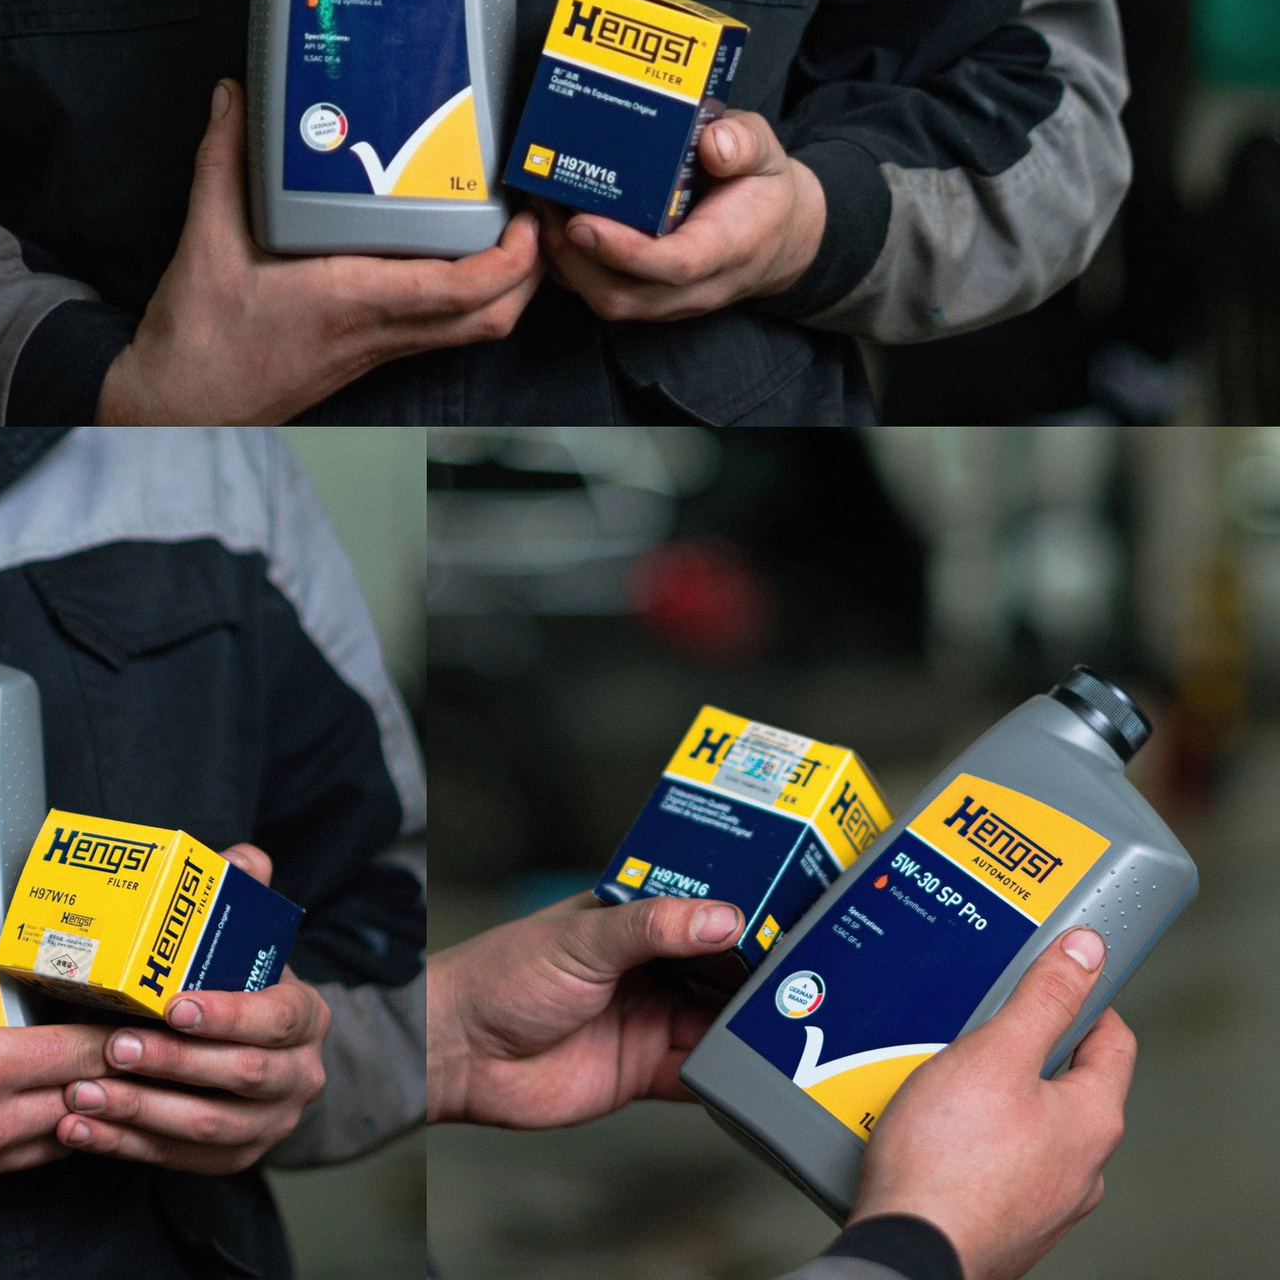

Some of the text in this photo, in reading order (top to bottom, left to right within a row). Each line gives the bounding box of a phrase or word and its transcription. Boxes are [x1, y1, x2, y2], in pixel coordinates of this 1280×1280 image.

[373, 0, 382, 7] oil
[563, 0, 699, 67] Hengst
[644, 66, 683, 86] FILTER
[557, 153, 616, 184] H97W16
[683, 809, 691, 817] de
[42, 827, 158, 874] Hengst
[943, 795, 1063, 884] Hengst
[107, 877, 139, 891] FILTER
[651, 866, 710, 896] H97W16
[891, 852, 988, 930] 5W-30 SP Pro
[972, 855, 1031, 901] AUTOMOTIVE
[28, 885, 77, 906] H97W16
[197, 876, 215, 914] FILTER
[889, 885, 937, 924] Fully Synthetic oil
[17, 922, 25, 940] 1
[60, 912, 94, 928] Hengst
[138, 856, 204, 998] Hengst
[840, 914, 861, 930] API SP
[848, 905, 884, 936] Specifications:
[201, 928, 222, 971] Equipamento
[218, 904, 231, 929] Original
[832, 923, 862, 949] ILSAC GF-6
[243, 949, 268, 993] 7W16
[787, 993, 808, 1006] BRAND
[789, 985, 814, 1000] GERMAN
